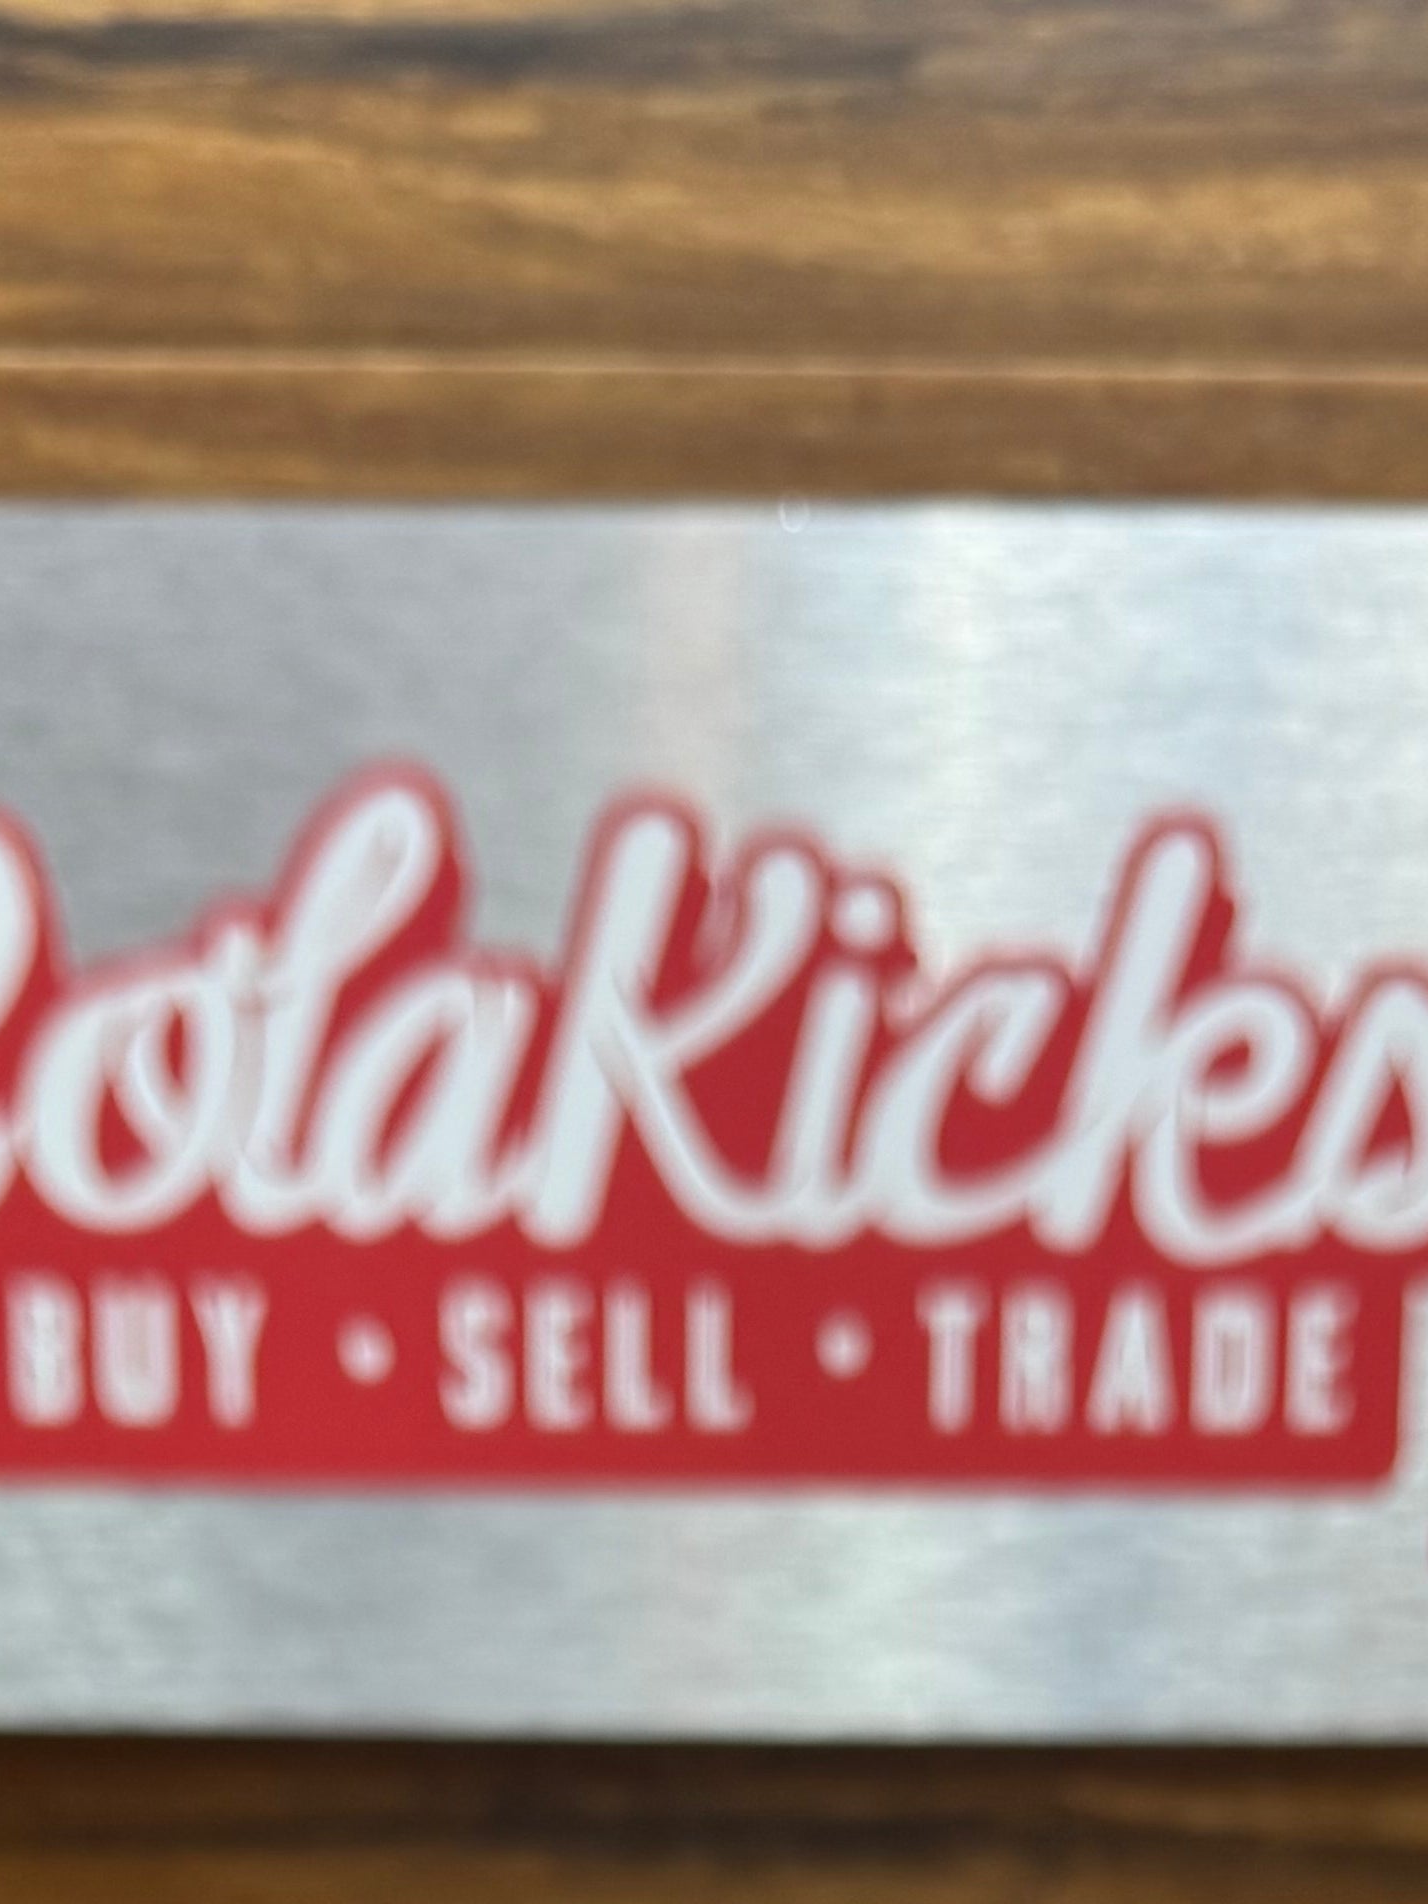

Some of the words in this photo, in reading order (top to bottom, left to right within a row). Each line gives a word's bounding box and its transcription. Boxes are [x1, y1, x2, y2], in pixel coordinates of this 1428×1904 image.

[4, 1276, 266, 1428] BUY
[436, 1280, 754, 1432] SELL
[918, 1282, 1356, 1436] TRADE
